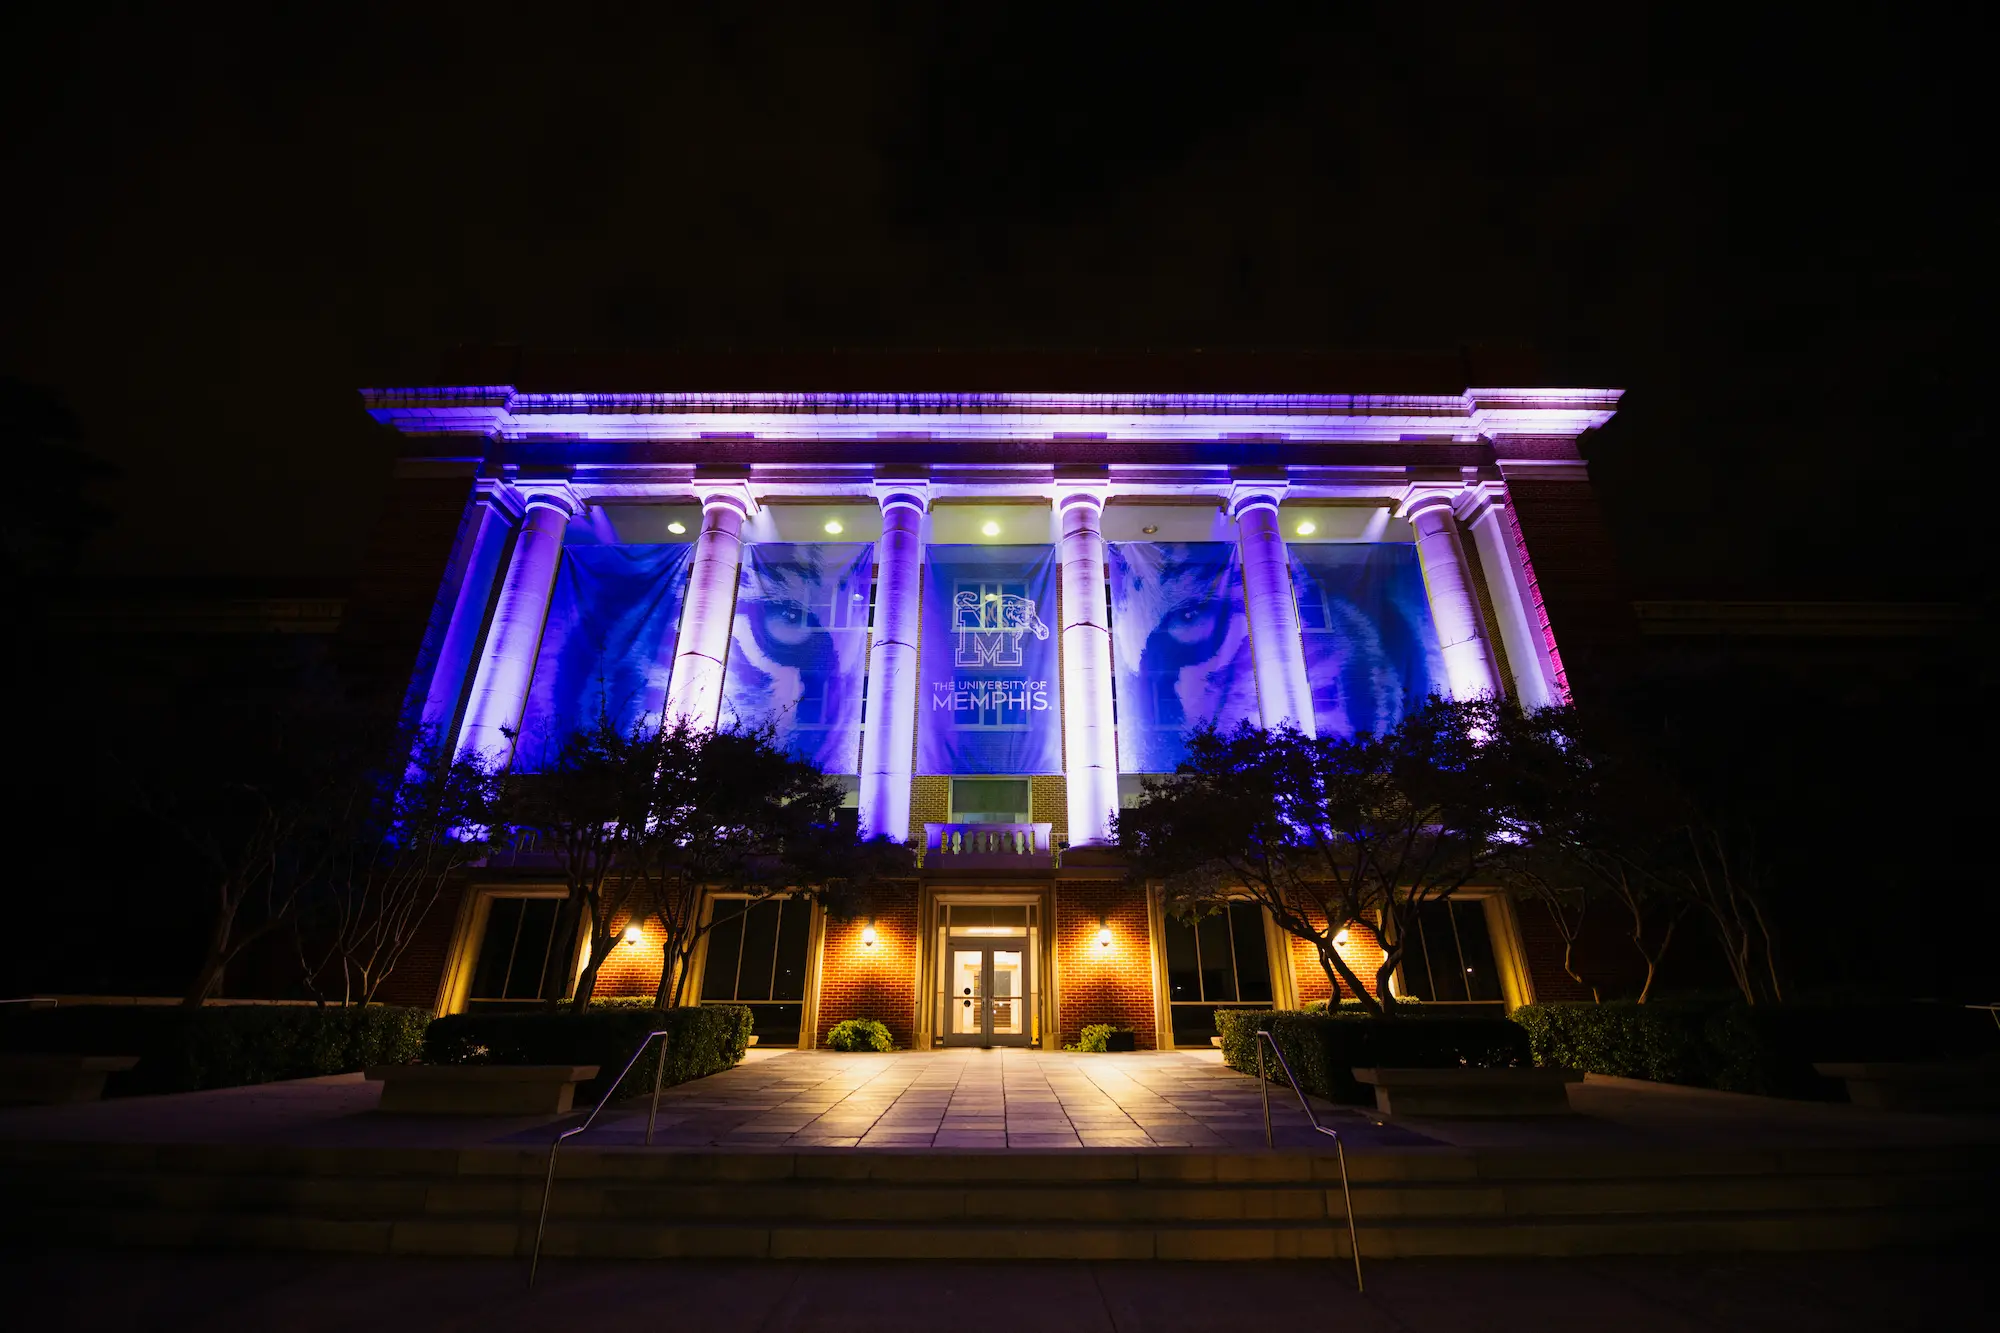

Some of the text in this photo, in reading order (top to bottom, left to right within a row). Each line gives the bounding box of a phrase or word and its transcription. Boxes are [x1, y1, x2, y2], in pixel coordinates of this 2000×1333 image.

[933, 680, 1047, 691] THE UNIVERSITY OF
